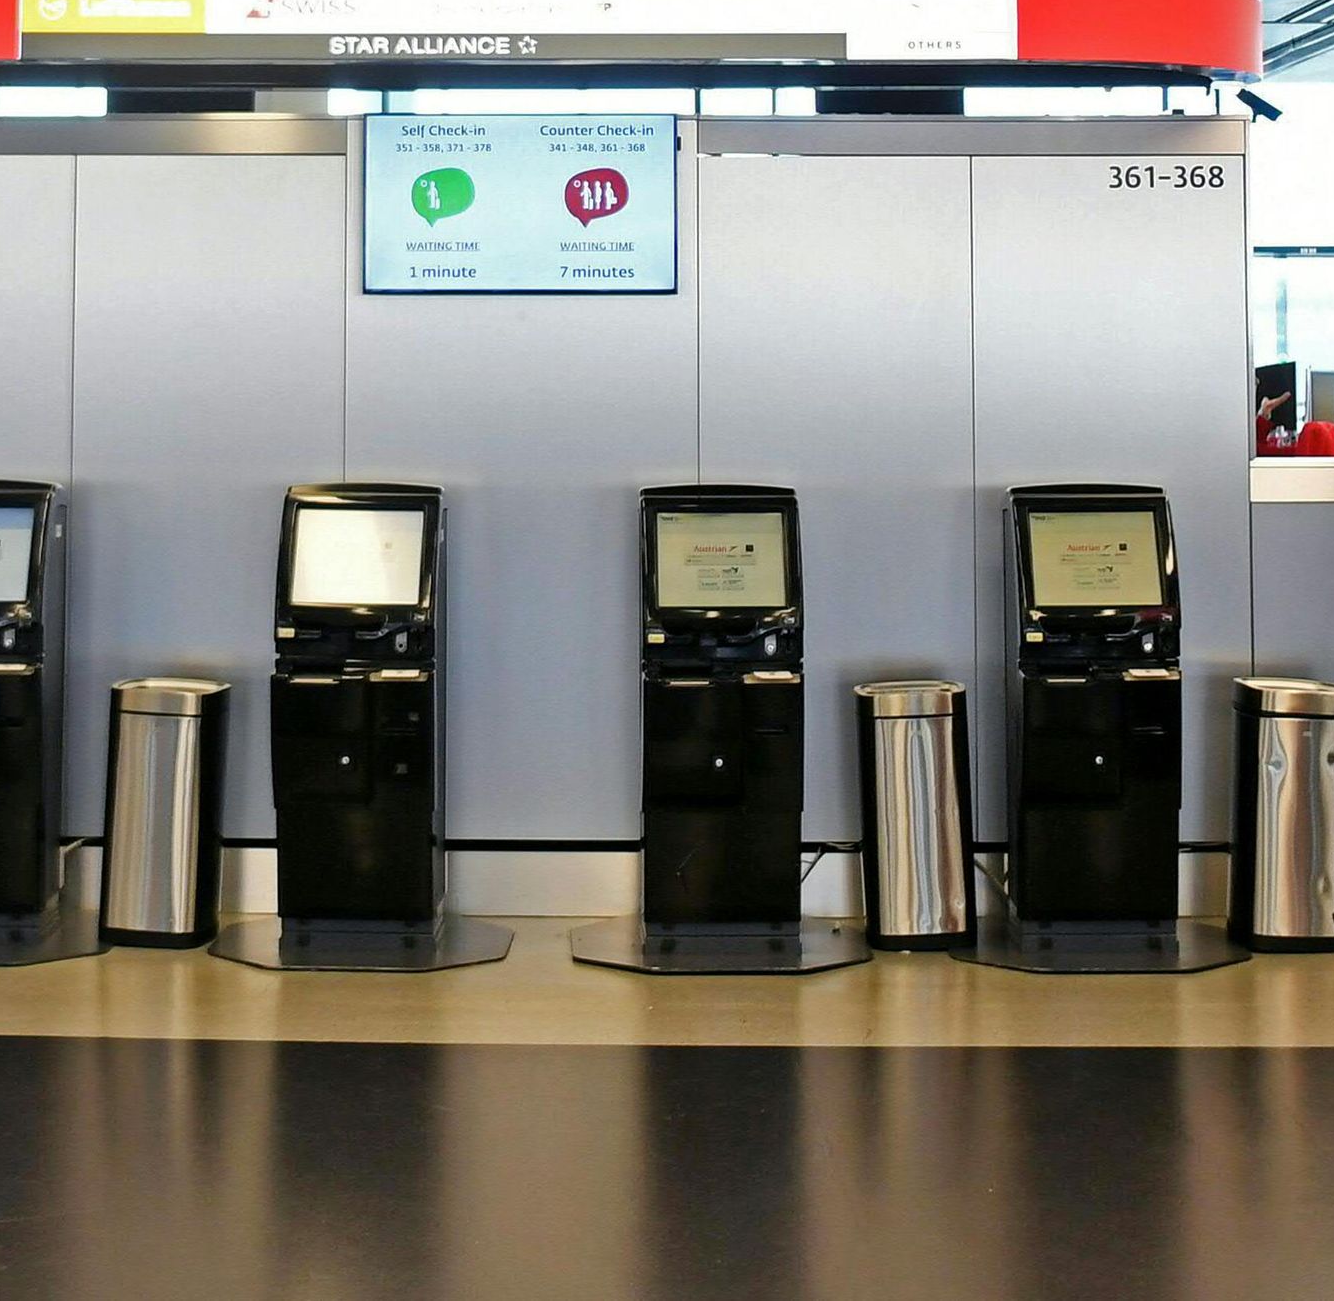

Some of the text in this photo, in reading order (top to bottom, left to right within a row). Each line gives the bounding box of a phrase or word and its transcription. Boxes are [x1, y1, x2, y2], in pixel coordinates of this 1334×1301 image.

[328, 36, 511, 55] STAR ALLIANCE
[907, 40, 962, 50] OTHERS
[401, 125, 486, 138] Self Check-in
[540, 124, 654, 136] Counter Check-in
[395, 143, 413, 152] 351
[423, 143, 444, 153] 358,
[446, 143, 464, 152] 371
[474, 143, 492, 152] 378
[549, 143, 566, 152] 341
[577, 143, 598, 153] 348,
[601, 143, 618, 152] 361
[628, 143, 646, 152] 368
[406, 242, 480, 250] WAITING TIME
[560, 242, 635, 250] WAITING TIME
[410, 265, 477, 278] 1 minute
[560, 265, 635, 278] 7 minutes
